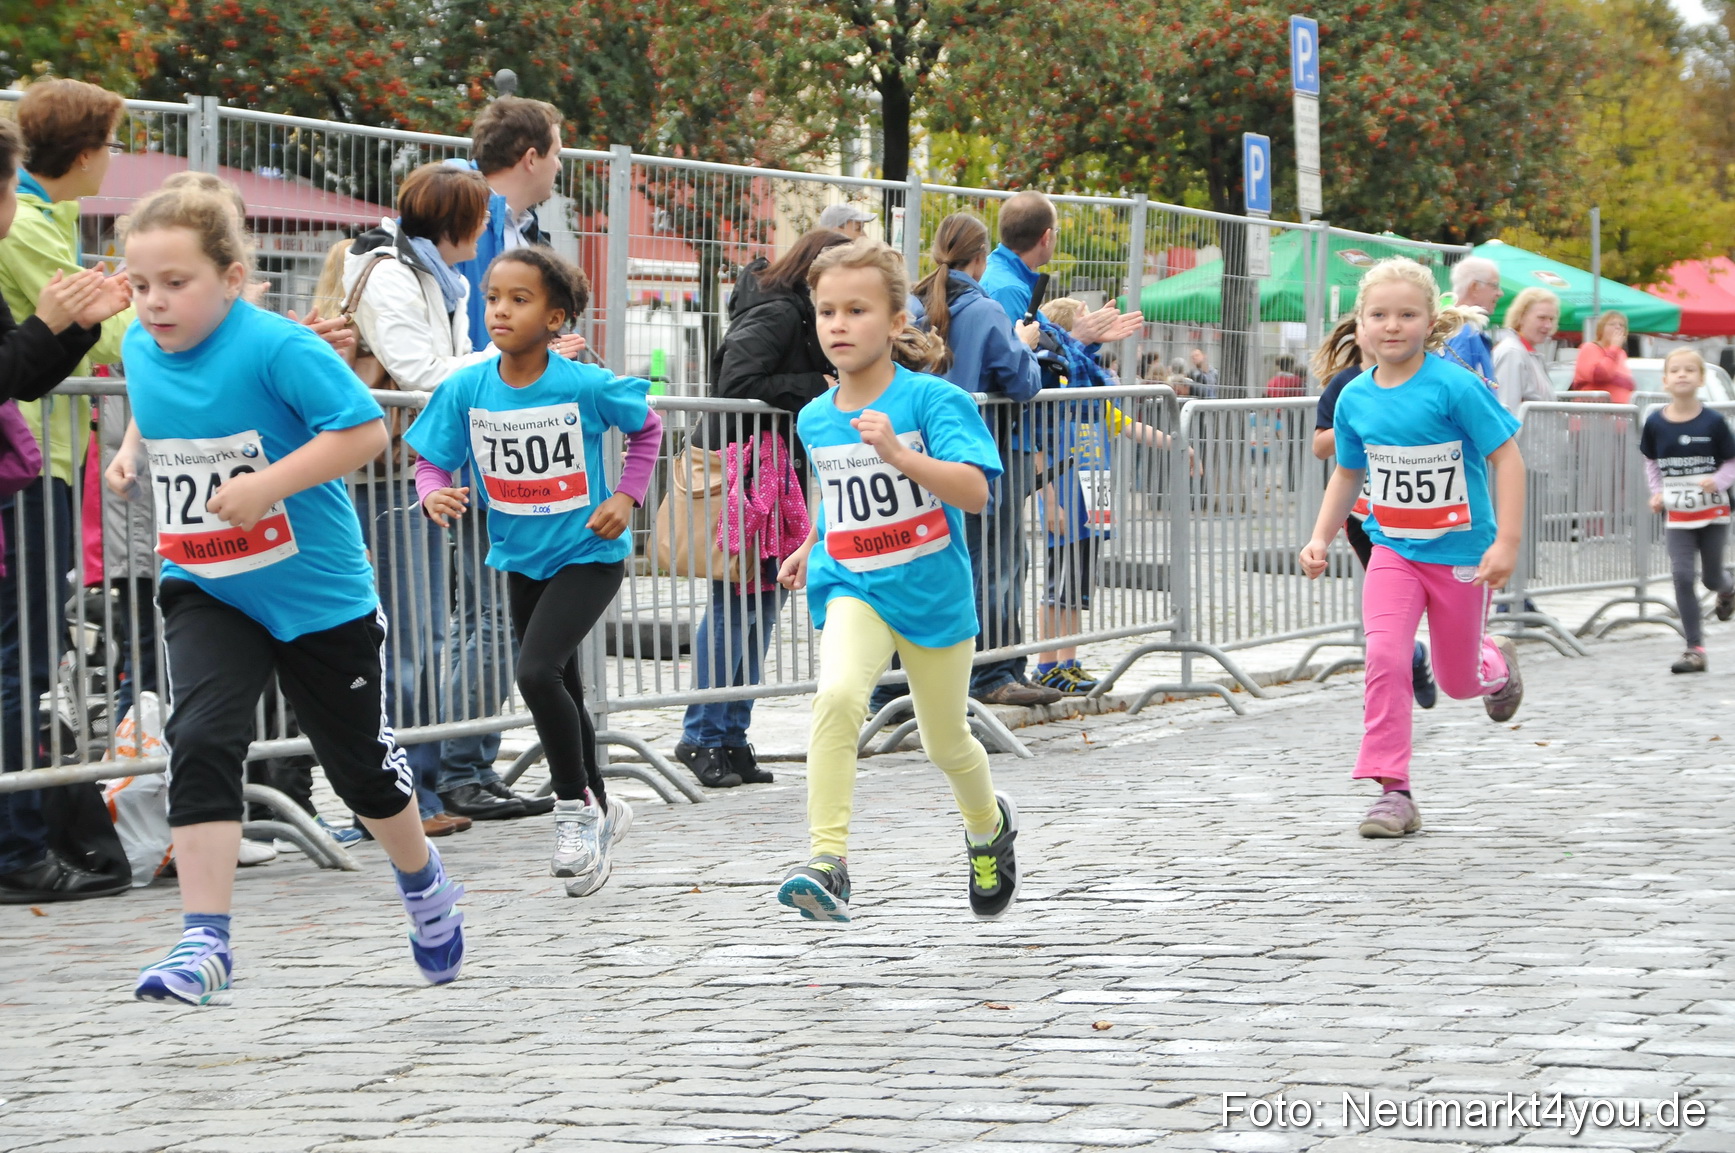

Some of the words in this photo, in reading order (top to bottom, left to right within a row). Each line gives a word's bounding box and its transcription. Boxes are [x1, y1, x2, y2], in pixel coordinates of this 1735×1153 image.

[1297, 27, 1312, 81] P
[1250, 145, 1265, 201] P
[503, 417, 560, 431] Neumarkt
[175, 450, 237, 466] Neumarkt
[483, 432, 574, 475] 7504
[817, 460, 845, 471] PARTL
[846, 456, 884, 468] Neuma
[1369, 452, 1397, 464] PARTL
[1399, 454, 1447, 465] Neumarkt
[156, 464, 256, 525] 724
[497, 480, 551, 498] Victoria
[1377, 466, 1456, 503] 7557
[827, 472, 924, 523] 7091
[182, 536, 249, 559] Nadine
[853, 529, 912, 554] Sophie
